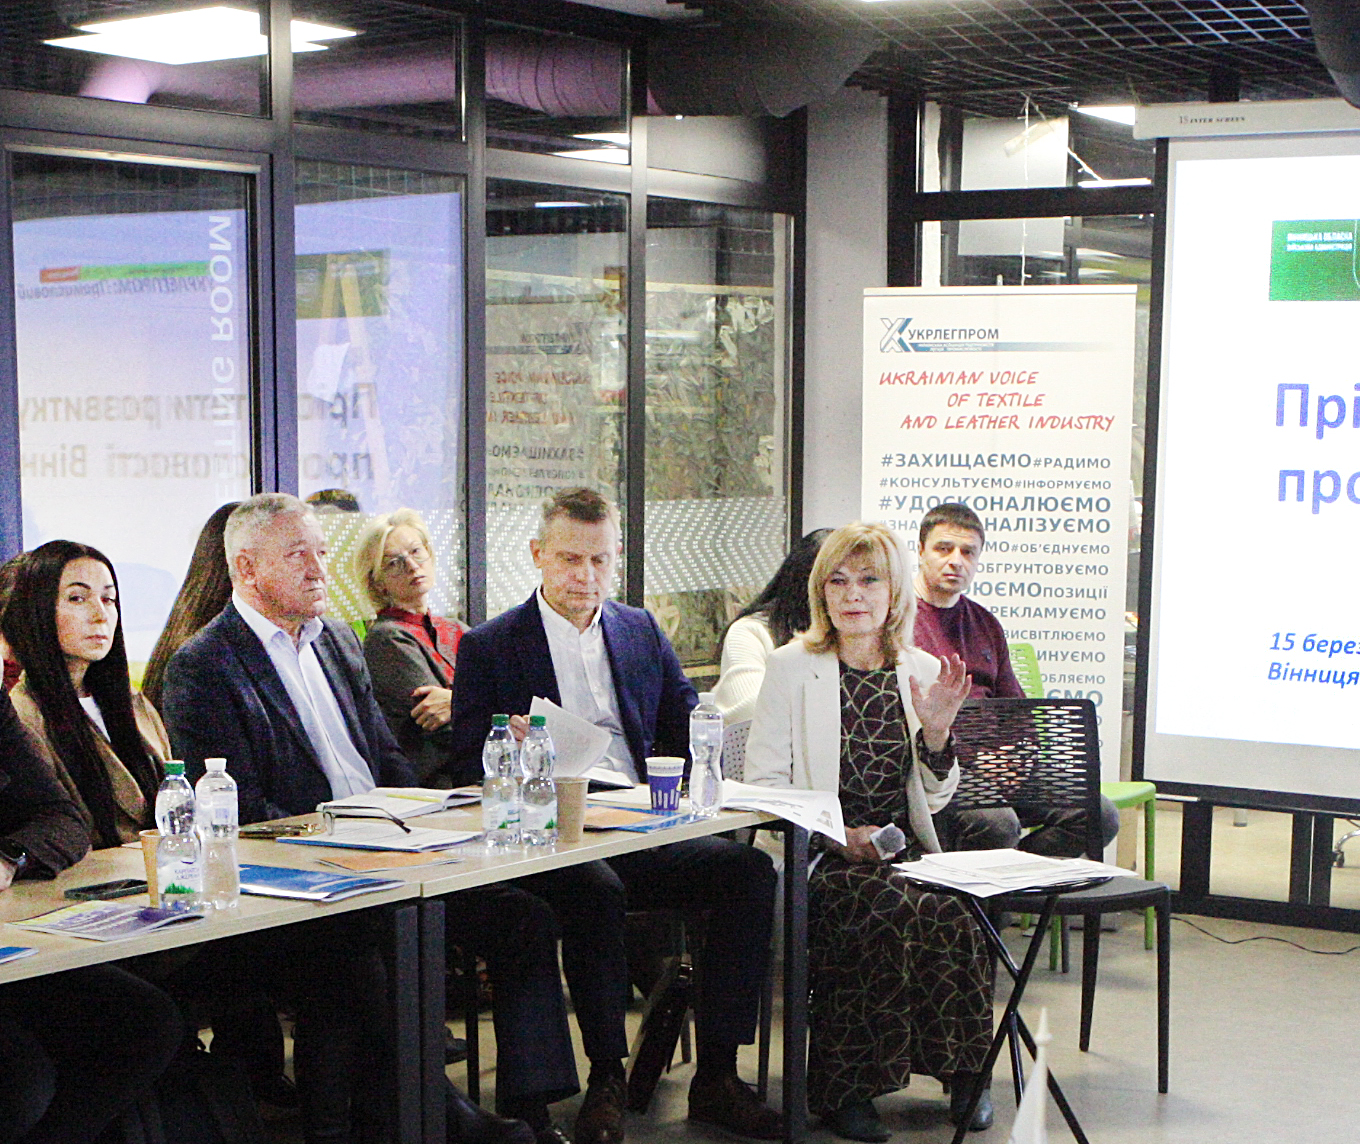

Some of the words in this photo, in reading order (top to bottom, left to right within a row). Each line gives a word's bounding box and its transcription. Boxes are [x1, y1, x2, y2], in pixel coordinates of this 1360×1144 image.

[908, 328, 1000, 340] УКРЛЕГПРОМ
[879, 370, 984, 385] UKRAINIAN
[989, 370, 1040, 384] VOICE
[947, 393, 971, 408] OF
[977, 393, 1046, 408] TEXTILE
[900, 414, 938, 429] AND
[944, 414, 1020, 430] LEATHER
[1028, 415, 1116, 432] INDUSTRY
[983, 517, 1111, 533] НАЛІЗУЄМО
[986, 605, 1106, 620] РЕКЛАМУЄМО
[1269, 631, 1296, 651] 15
[1267, 661, 1360, 689] Вінниця
